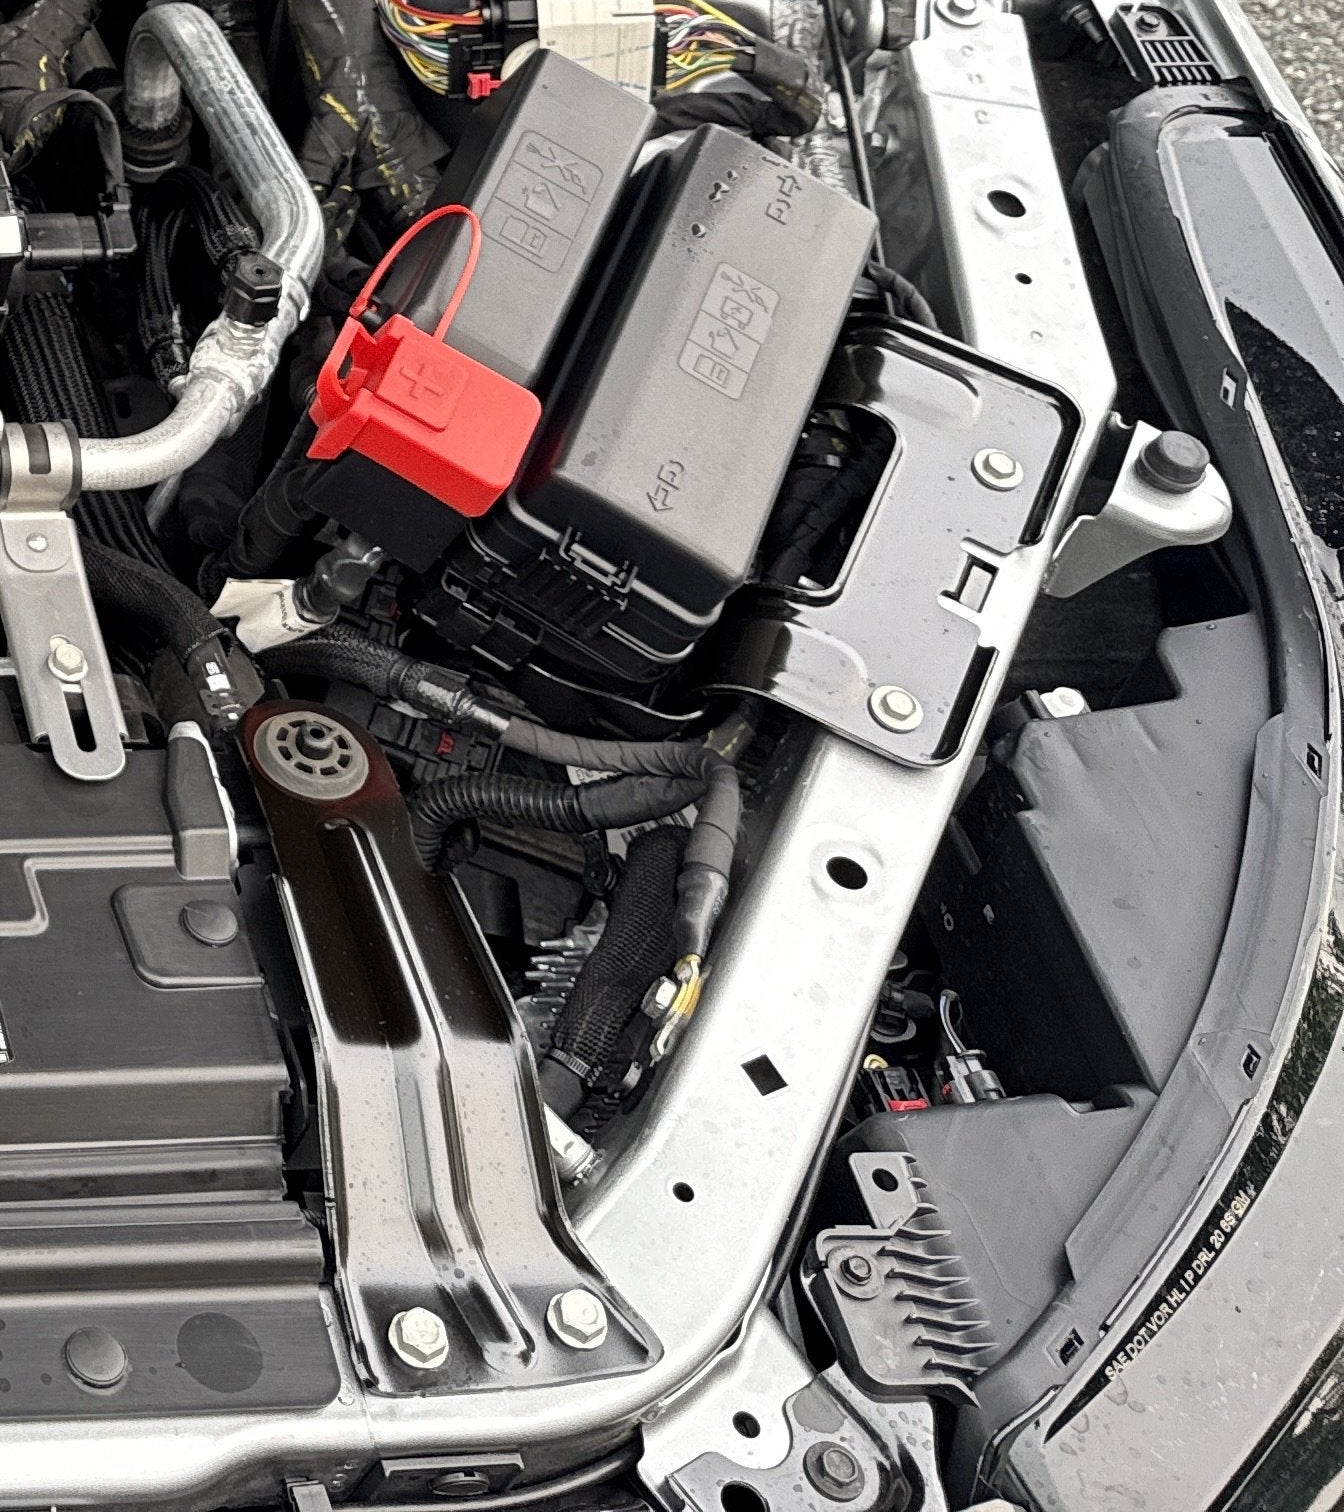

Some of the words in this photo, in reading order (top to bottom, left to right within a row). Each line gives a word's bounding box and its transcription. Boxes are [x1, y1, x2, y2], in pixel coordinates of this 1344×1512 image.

[1105, 1351, 1130, 1381] SAE
[1125, 1326, 1151, 1360] DOT
[1146, 1302, 1173, 1333] VOR
[1167, 1287, 1187, 1308] HL
[1184, 1269, 1196, 1286] P
[1192, 1246, 1216, 1276] DRL
[1210, 1229, 1226, 1249] 20
